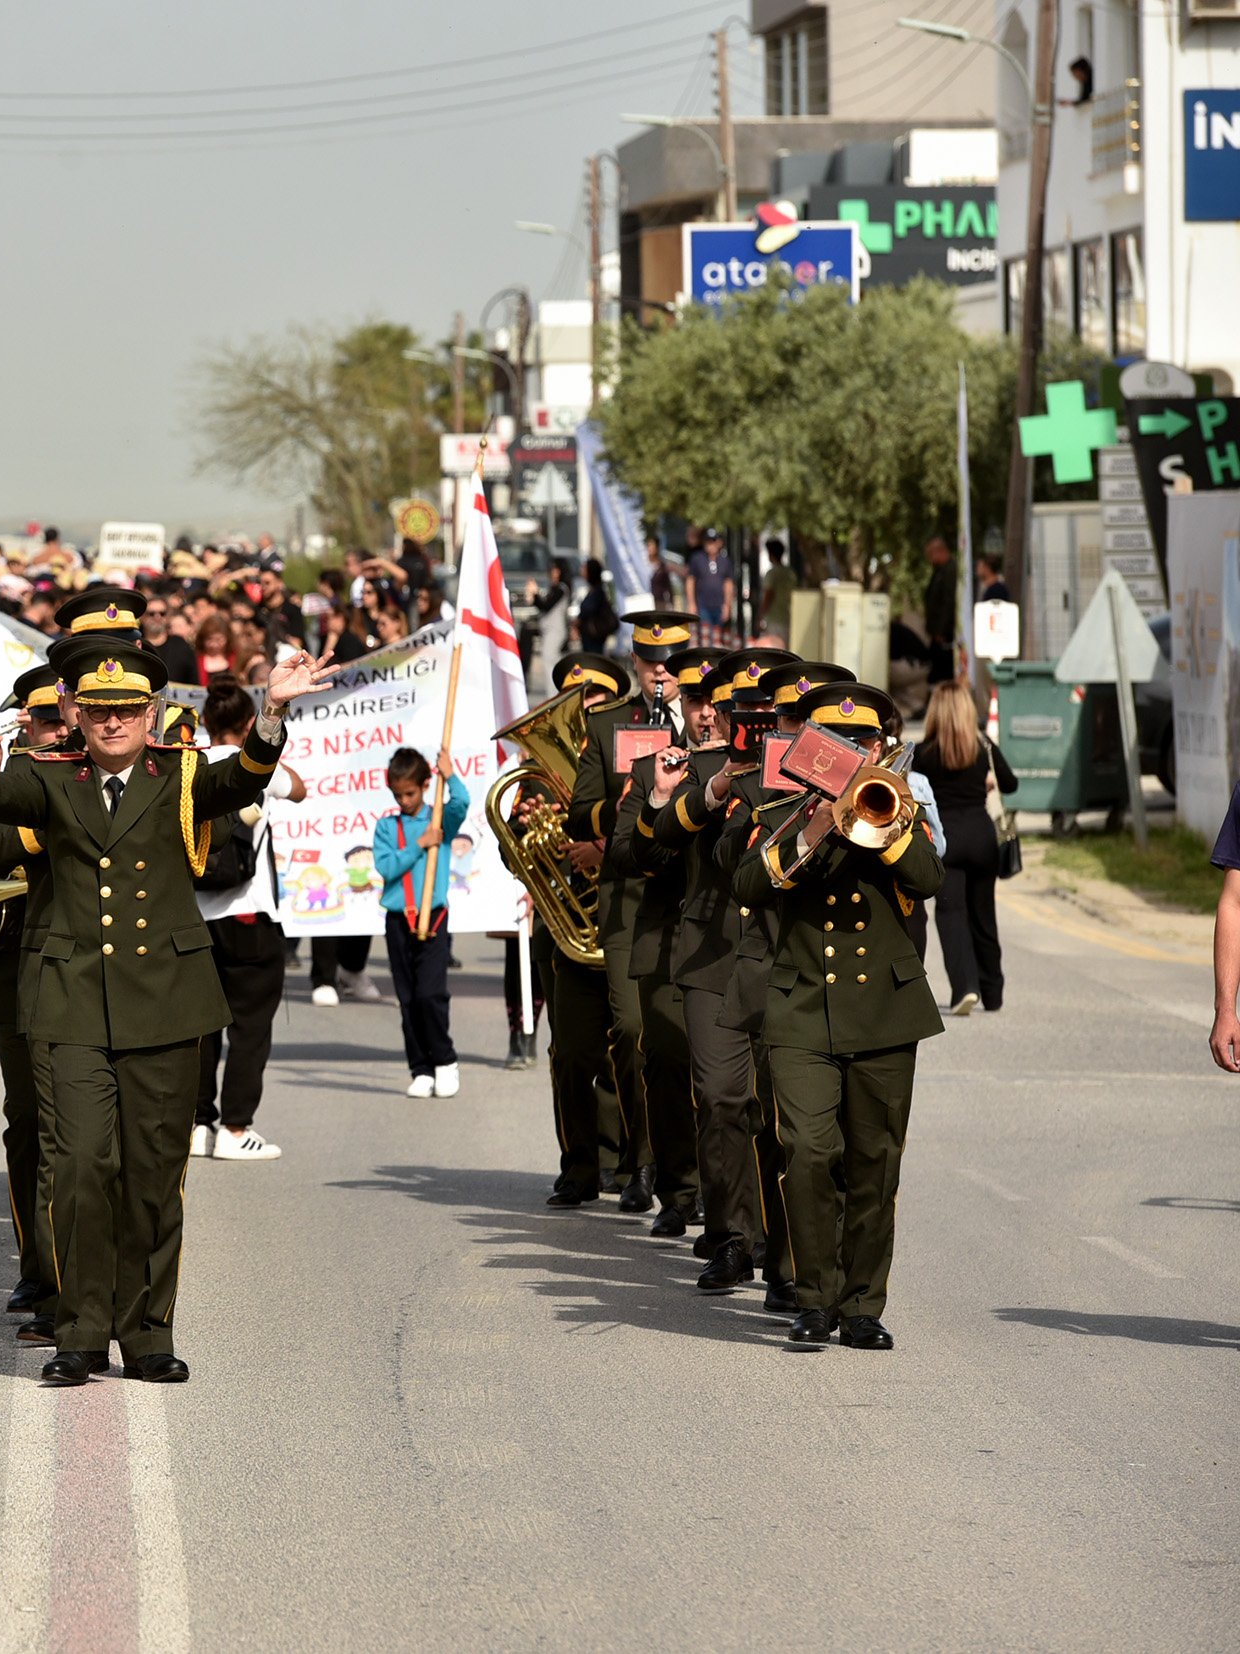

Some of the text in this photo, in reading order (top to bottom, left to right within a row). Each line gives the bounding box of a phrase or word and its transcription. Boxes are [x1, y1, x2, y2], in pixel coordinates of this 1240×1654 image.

[314, 687, 416, 721] DAİRESİ
[280, 723, 404, 760] 23 NİSAN
[455, 754, 487, 778] VE
